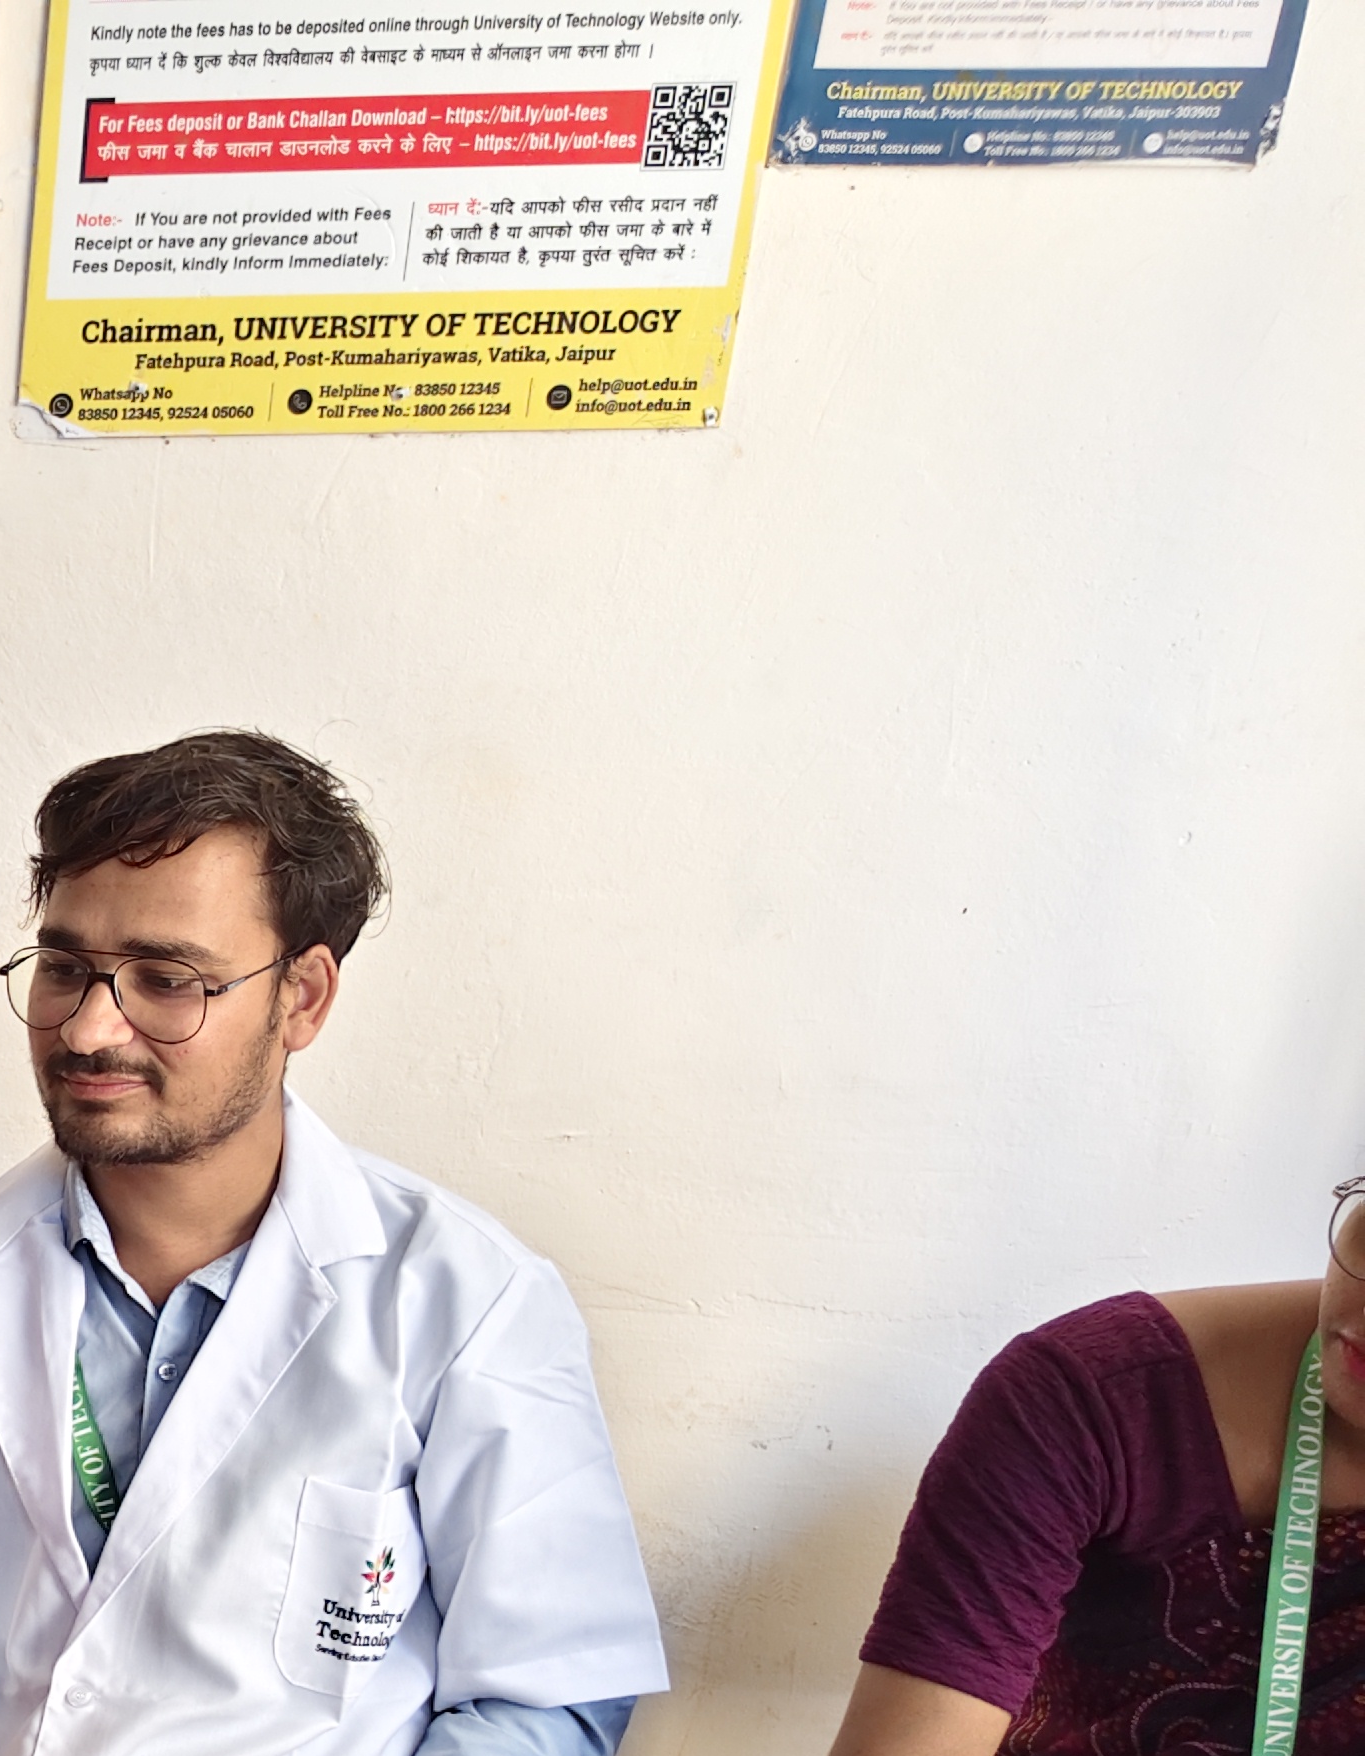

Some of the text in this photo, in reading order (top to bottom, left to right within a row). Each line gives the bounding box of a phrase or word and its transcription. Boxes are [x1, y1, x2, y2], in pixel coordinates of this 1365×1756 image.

[91, 10, 743, 43] Kindly note the fees has to be deposited online through University of Technology Website only.
[827, 81, 1243, 103] Chairman, UNIVERSITY OF TECHNOLOGY
[99, 104, 608, 134] For Fees deposit or Bank Challan Download https://bit.ly/uot-fees
[97, 131, 637, 161] फीस जमा व बैंक चालान डाउनलोड करने के लिए https://bit.ly/uot-fees
[136, 213, 146, 226] If
[151, 212, 177, 225] You
[183, 214, 207, 225] are
[213, 211, 237, 224] not
[243, 209, 311, 227] provided
[317, 208, 348, 221] with
[355, 207, 391, 220] Fees
[82, 310, 681, 346] Chairman, UNIVERSITY OF TECHNOLOGY
[135, 345, 616, 372] Fatehpura Road, Post-Kumahariyawas, Vatika, Jaipur
[79, 386, 173, 404] Whatsapp No
[579, 378, 697, 394] help@uot.edu.in
[78, 406, 254, 421] 83850 12345, 92524 05060
[575, 398, 691, 415] info@uot.edu.in
[1285, 1353, 1324, 1551] TECHNOLOGY
[1280, 1555, 1311, 1594] OF
